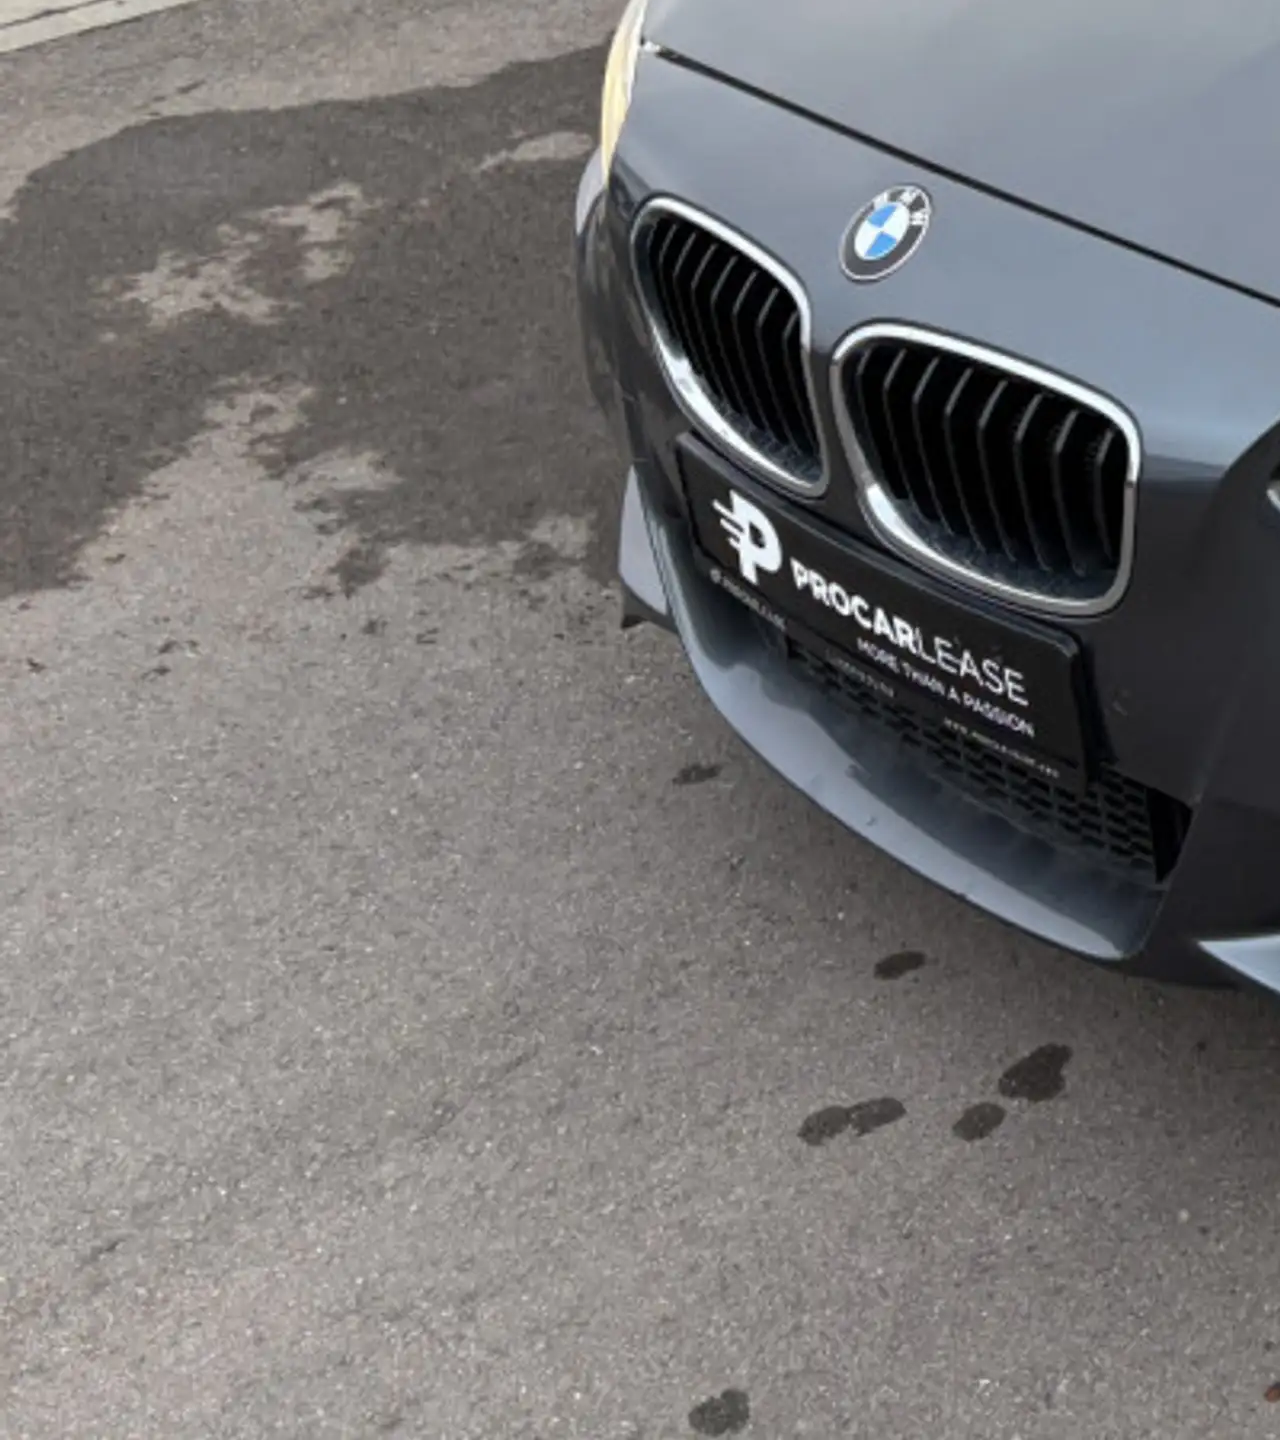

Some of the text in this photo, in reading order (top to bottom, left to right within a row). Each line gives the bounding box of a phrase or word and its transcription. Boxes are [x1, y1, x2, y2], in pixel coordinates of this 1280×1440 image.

[789, 556, 1030, 708] PROCARLEASE
[947, 686, 961, 705] A
[962, 691, 1036, 738] PASSION
